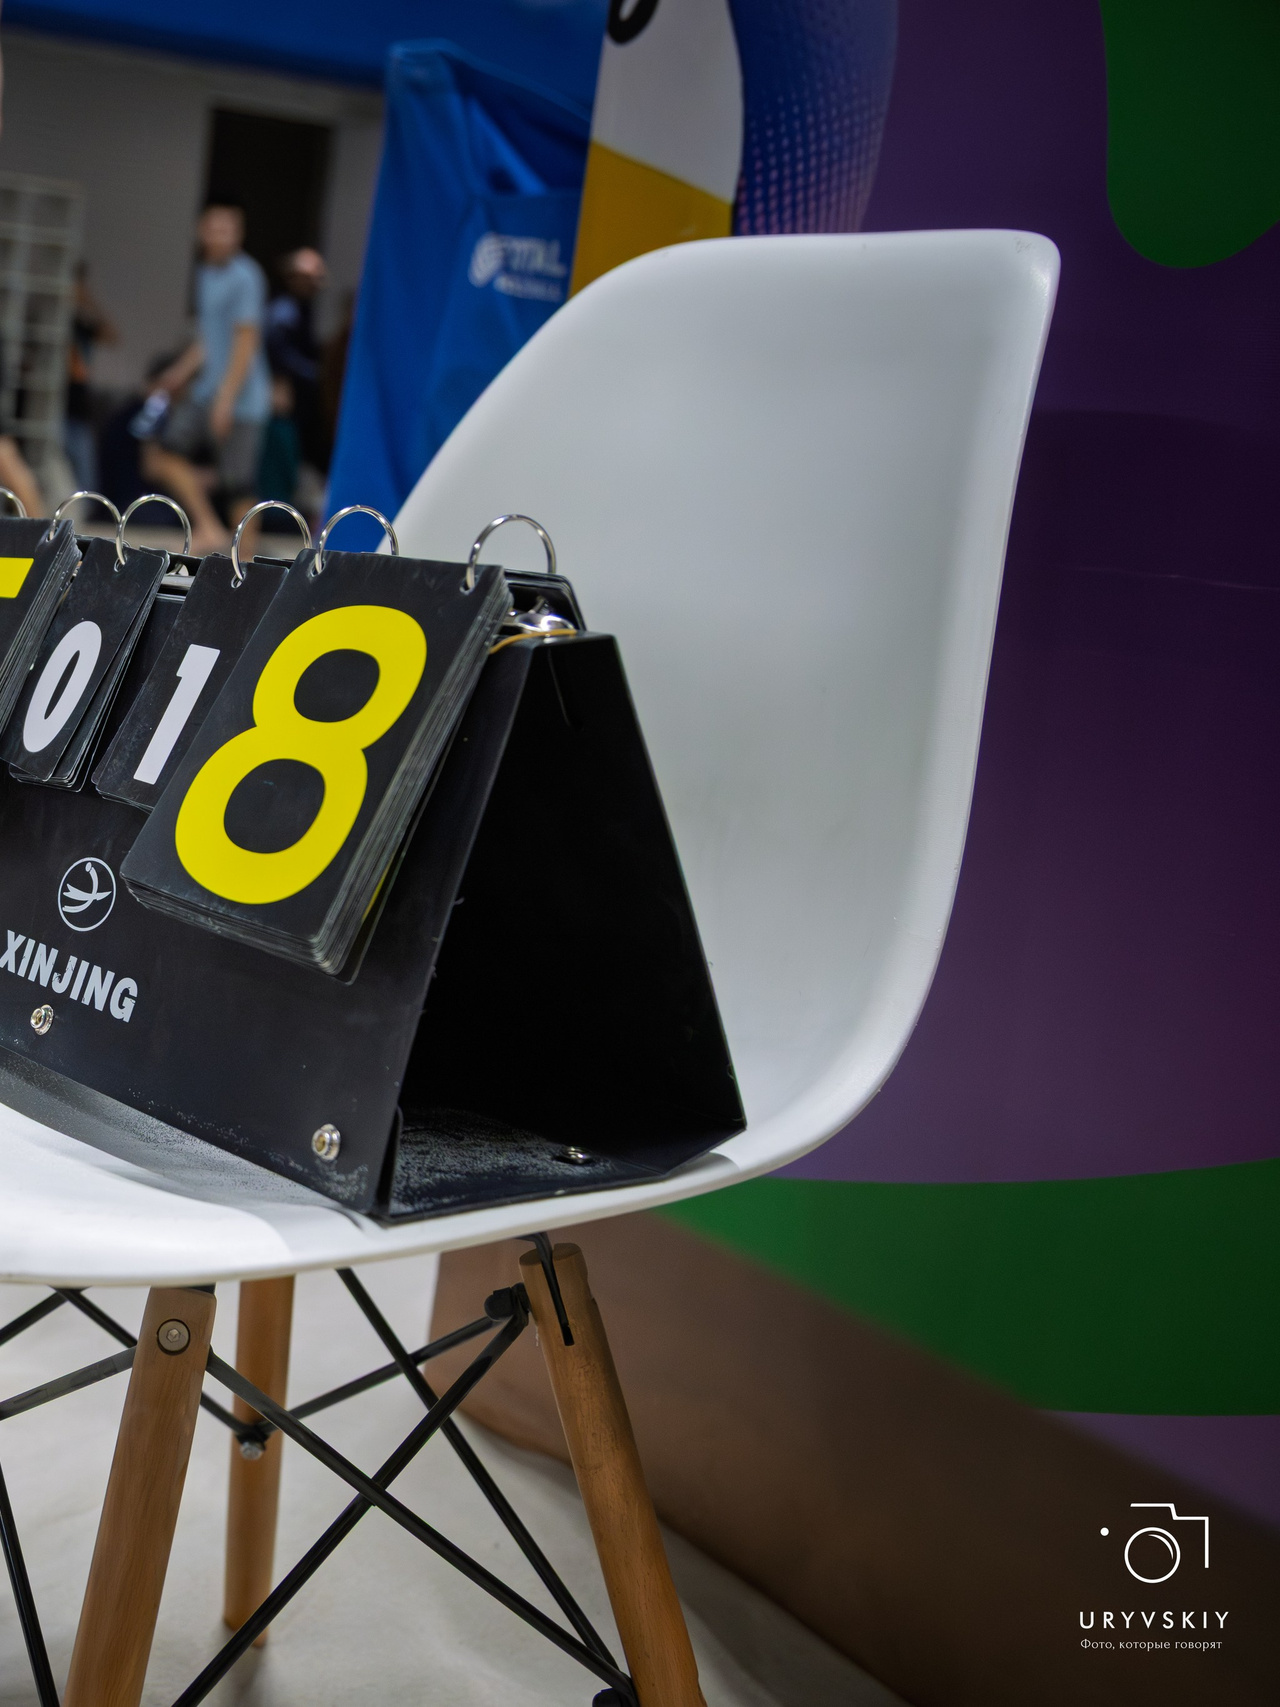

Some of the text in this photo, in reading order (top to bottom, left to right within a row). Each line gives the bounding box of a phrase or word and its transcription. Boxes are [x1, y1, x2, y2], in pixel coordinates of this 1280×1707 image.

[23, 620, 102, 753] 0
[133, 644, 220, 785] 1
[175, 605, 427, 905] 8
